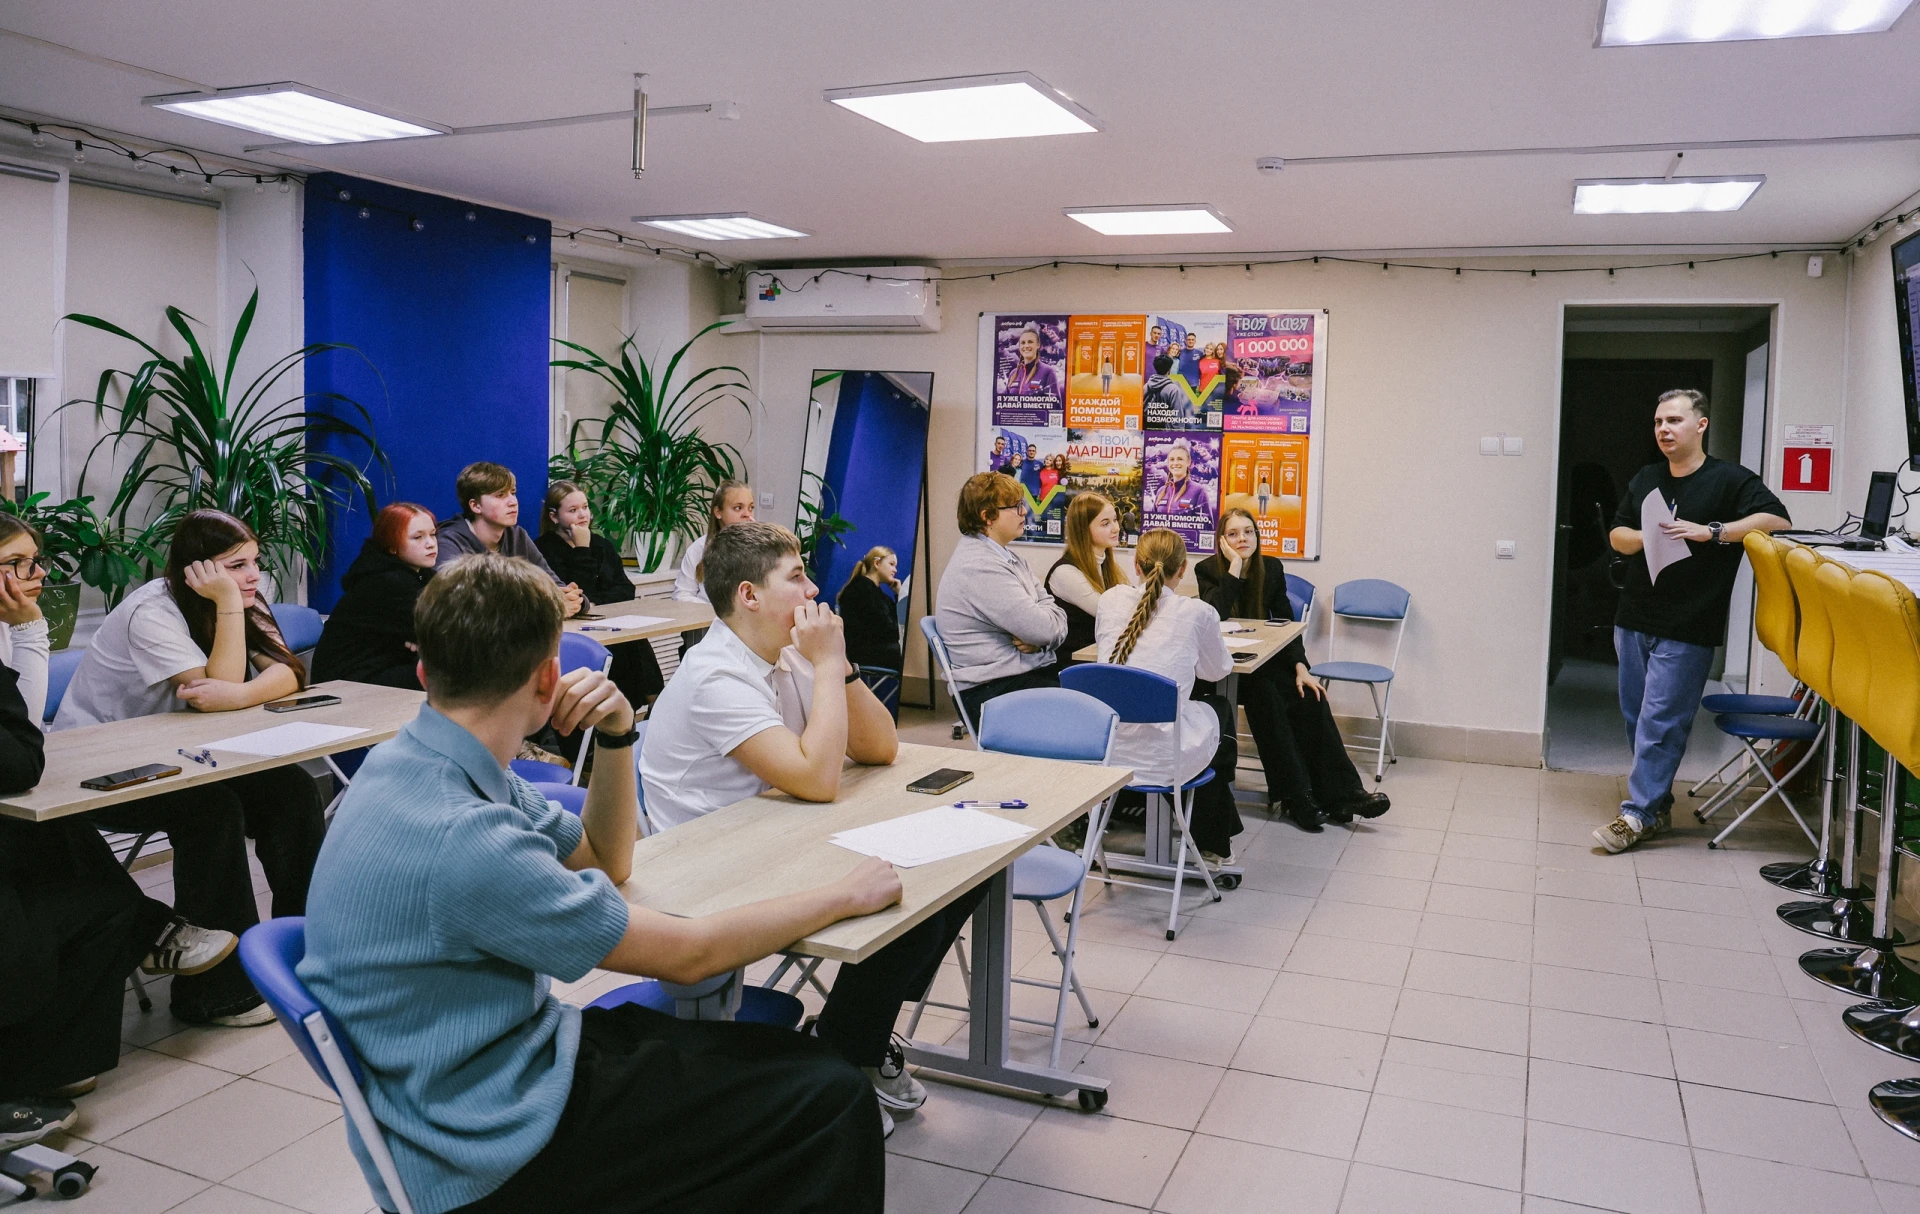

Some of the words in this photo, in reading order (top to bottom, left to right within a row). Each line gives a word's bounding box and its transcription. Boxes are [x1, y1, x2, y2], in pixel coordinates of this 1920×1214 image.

[1234, 318, 1268, 330] ТВОЯ
[1238, 341, 1245, 354] 1
[1248, 339, 1277, 353] 000
[1279, 337, 1309, 352] 000
[996, 401, 1022, 409] ДАВАЙ
[1070, 398, 1077, 406] У
[1079, 397, 1121, 406] КАЖДОЙ
[1070, 406, 1121, 416] ПОМОЩИ
[1070, 415, 1093, 423] СВОЯ
[1093, 416, 1121, 424] ДВЕРЬ
[1146, 416, 1203, 424] ВОЗМОЖНОСТИ
[1098, 434, 1130, 446] ТВОЙ
[1066, 445, 1142, 459] МАРШРУТ
[1143, 519, 1170, 527] ДАВАЙ
[1171, 521, 1205, 529] ВМЕСТЕ!
[1168, 515, 1211, 524] ПОМОГАЮ,
[1257, 519, 1278, 528] ДОЙ
